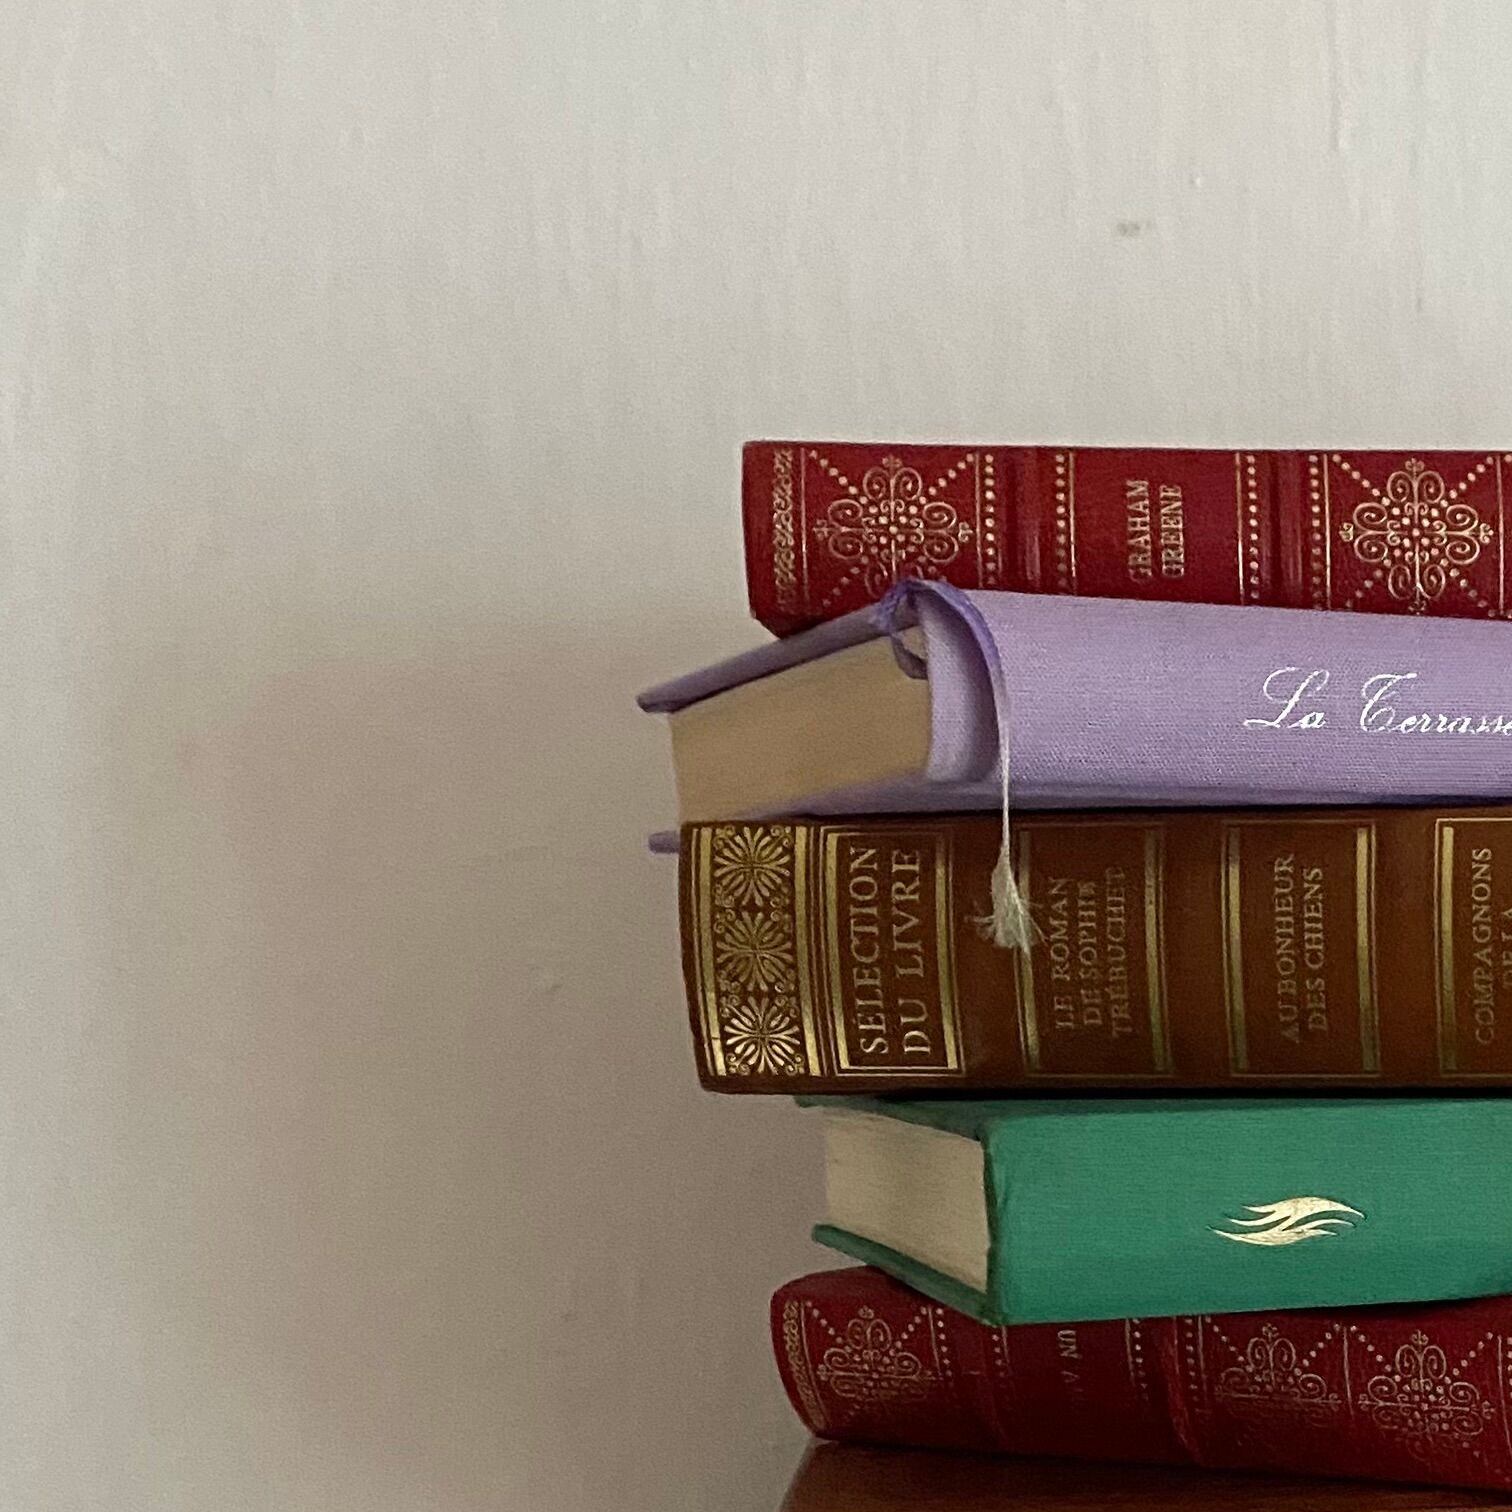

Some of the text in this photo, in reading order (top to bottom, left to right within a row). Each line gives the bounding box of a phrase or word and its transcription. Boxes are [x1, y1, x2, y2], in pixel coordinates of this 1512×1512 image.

[1126, 479, 1152, 583] GRAHAM
[1159, 484, 1184, 577] GREENE
[1243, 667, 1330, 729] La
[891, 850, 931, 1054] DU LIVRE
[1049, 877, 1074, 1030] LE ROMAN
[1078, 881, 1101, 1026] DE SOPHIE
[1274, 854, 1300, 1043] AU BONHEUR
[1304, 867, 1327, 1031] DES CHIENS
[1472, 848, 1495, 1044] COMPAGNONS
